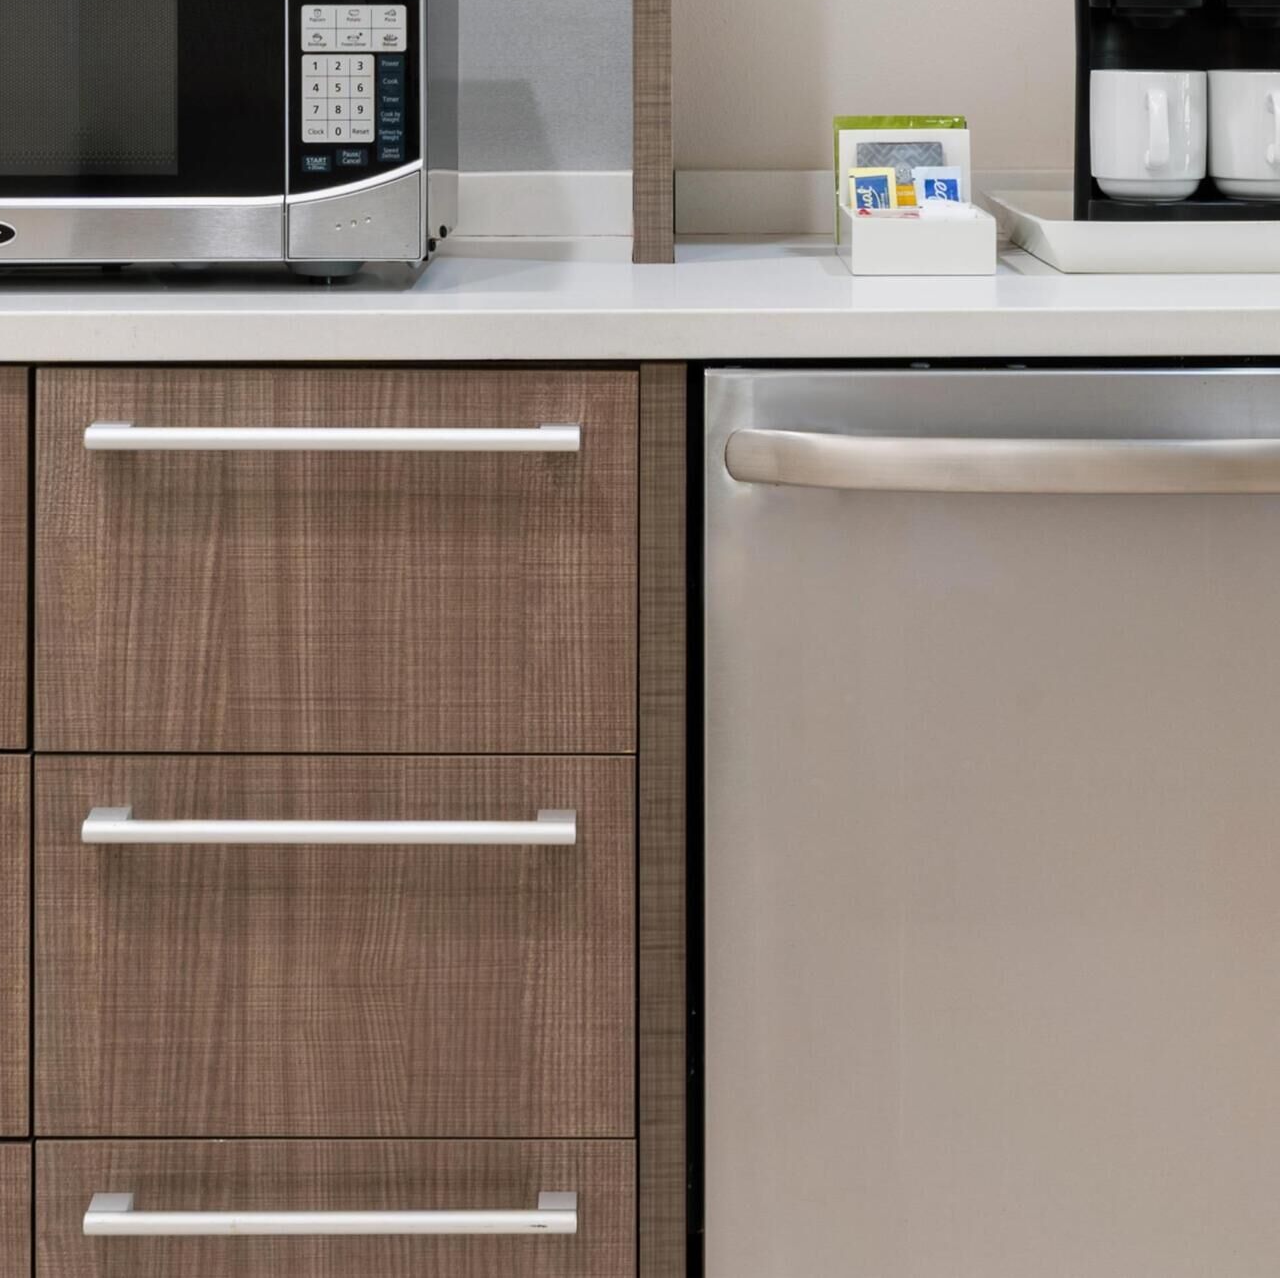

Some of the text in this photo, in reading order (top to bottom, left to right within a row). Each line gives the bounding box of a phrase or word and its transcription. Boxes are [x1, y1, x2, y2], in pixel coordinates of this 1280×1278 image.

[313, 61, 363, 71] 1 2 3
[312, 83, 364, 92] 4 5 6
[313, 105, 363, 114] 7 8 9
[335, 127, 341, 136] 0
